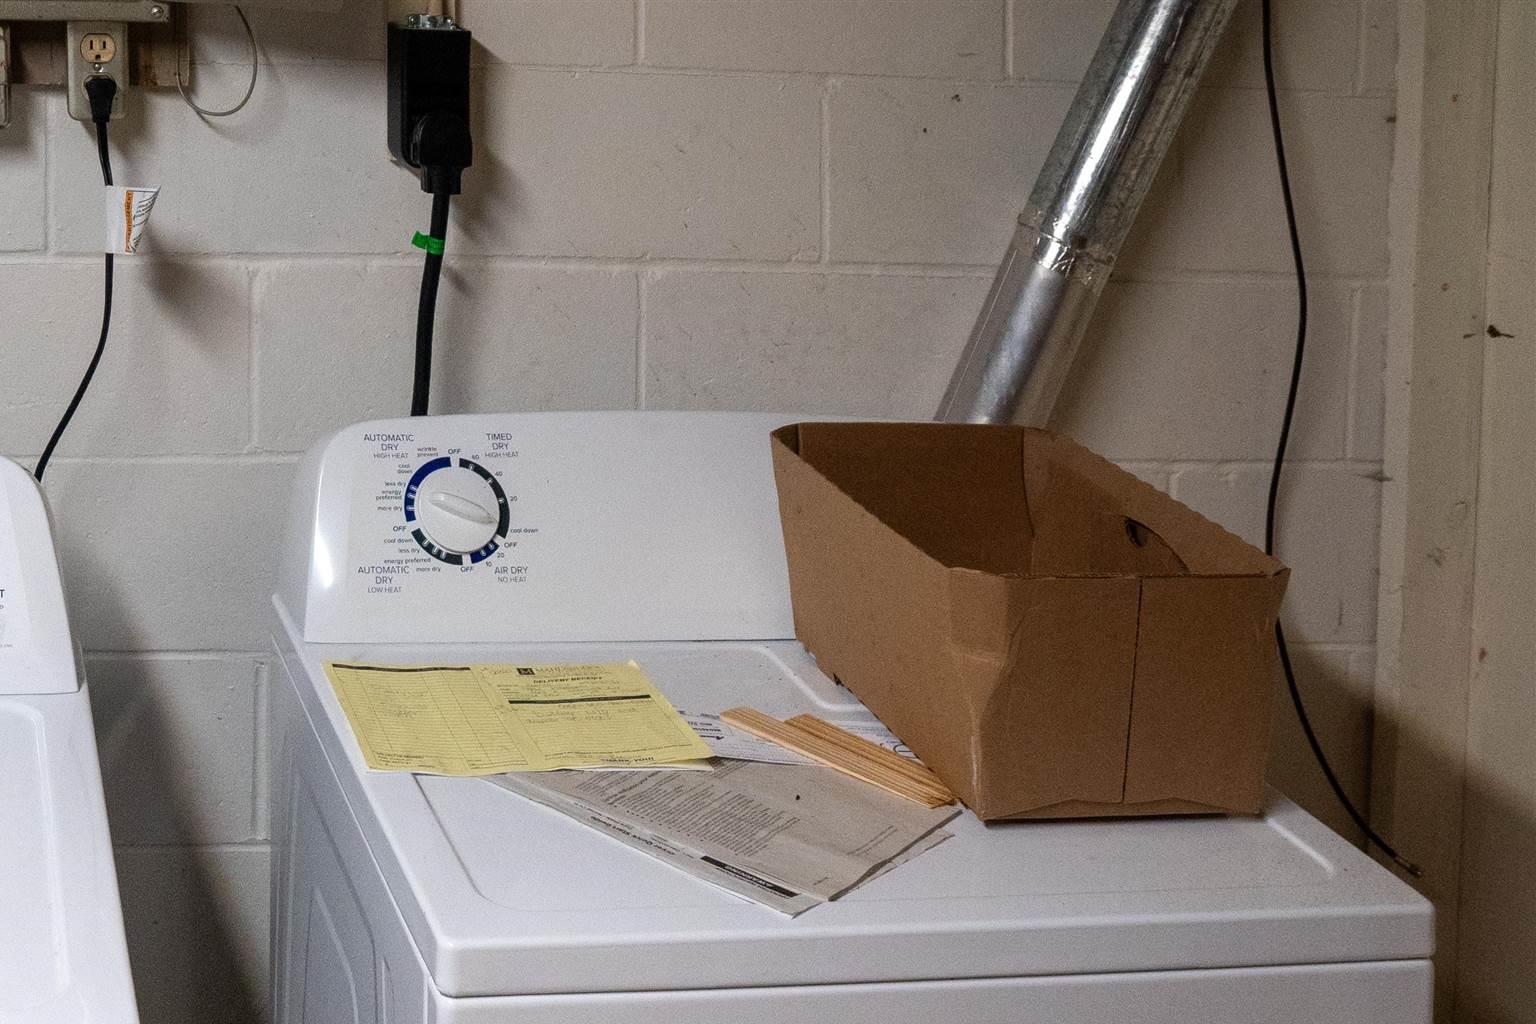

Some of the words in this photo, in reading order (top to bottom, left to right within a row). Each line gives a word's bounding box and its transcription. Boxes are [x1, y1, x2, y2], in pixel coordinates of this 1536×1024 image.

[363, 433, 414, 442] AUTOMATIC
[486, 433, 513, 441] TIMED
[381, 443, 399, 451] DRY
[358, 566, 410, 574] AUTOMATIC
[511, 566, 528, 574] DRY
[375, 576, 393, 584] DRY
